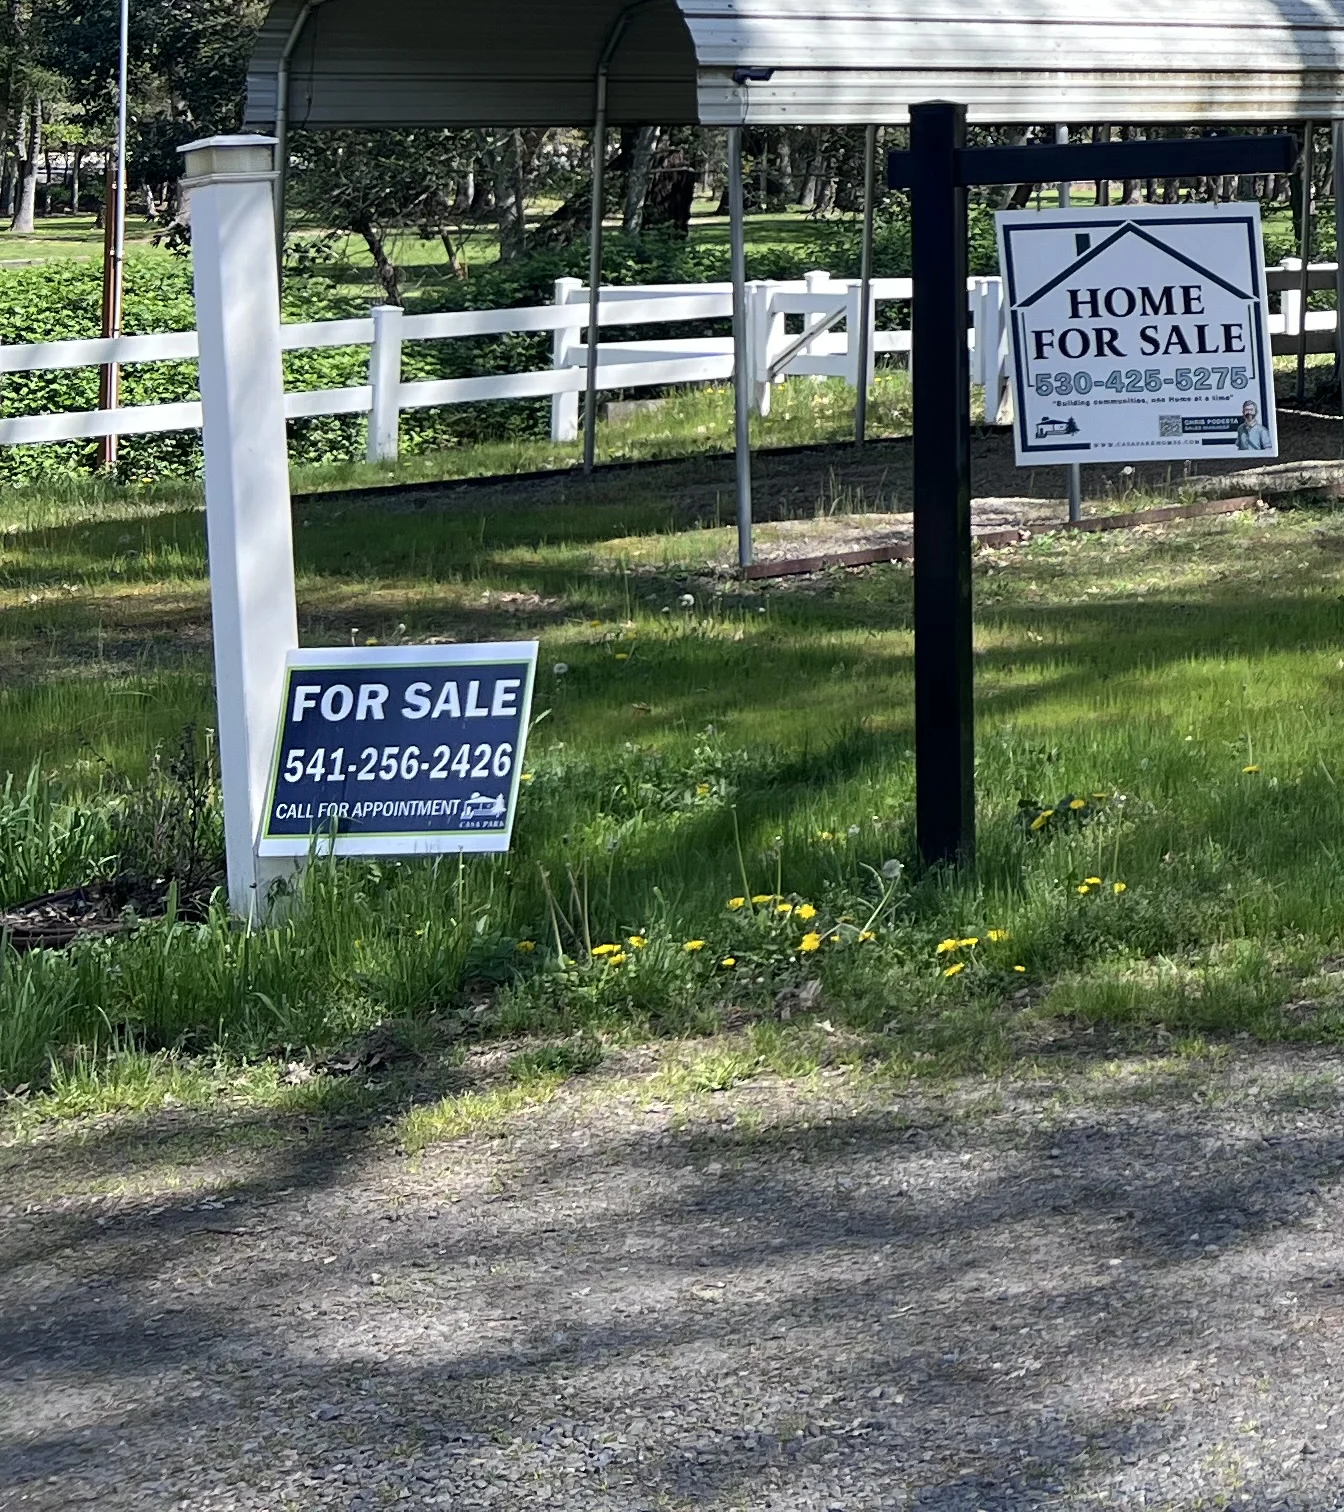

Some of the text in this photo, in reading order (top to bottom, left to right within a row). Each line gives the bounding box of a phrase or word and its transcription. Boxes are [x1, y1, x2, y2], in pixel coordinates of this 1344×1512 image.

[1066, 285, 1205, 319] HOME
[1031, 323, 1246, 360] FOR SALE
[1034, 366, 1249, 397] 530-425-5275
[292, 678, 521, 722] FOR SALE
[283, 742, 513, 783] 541-256-2426
[275, 798, 462, 819] CALL FOR APPOINTMENT
